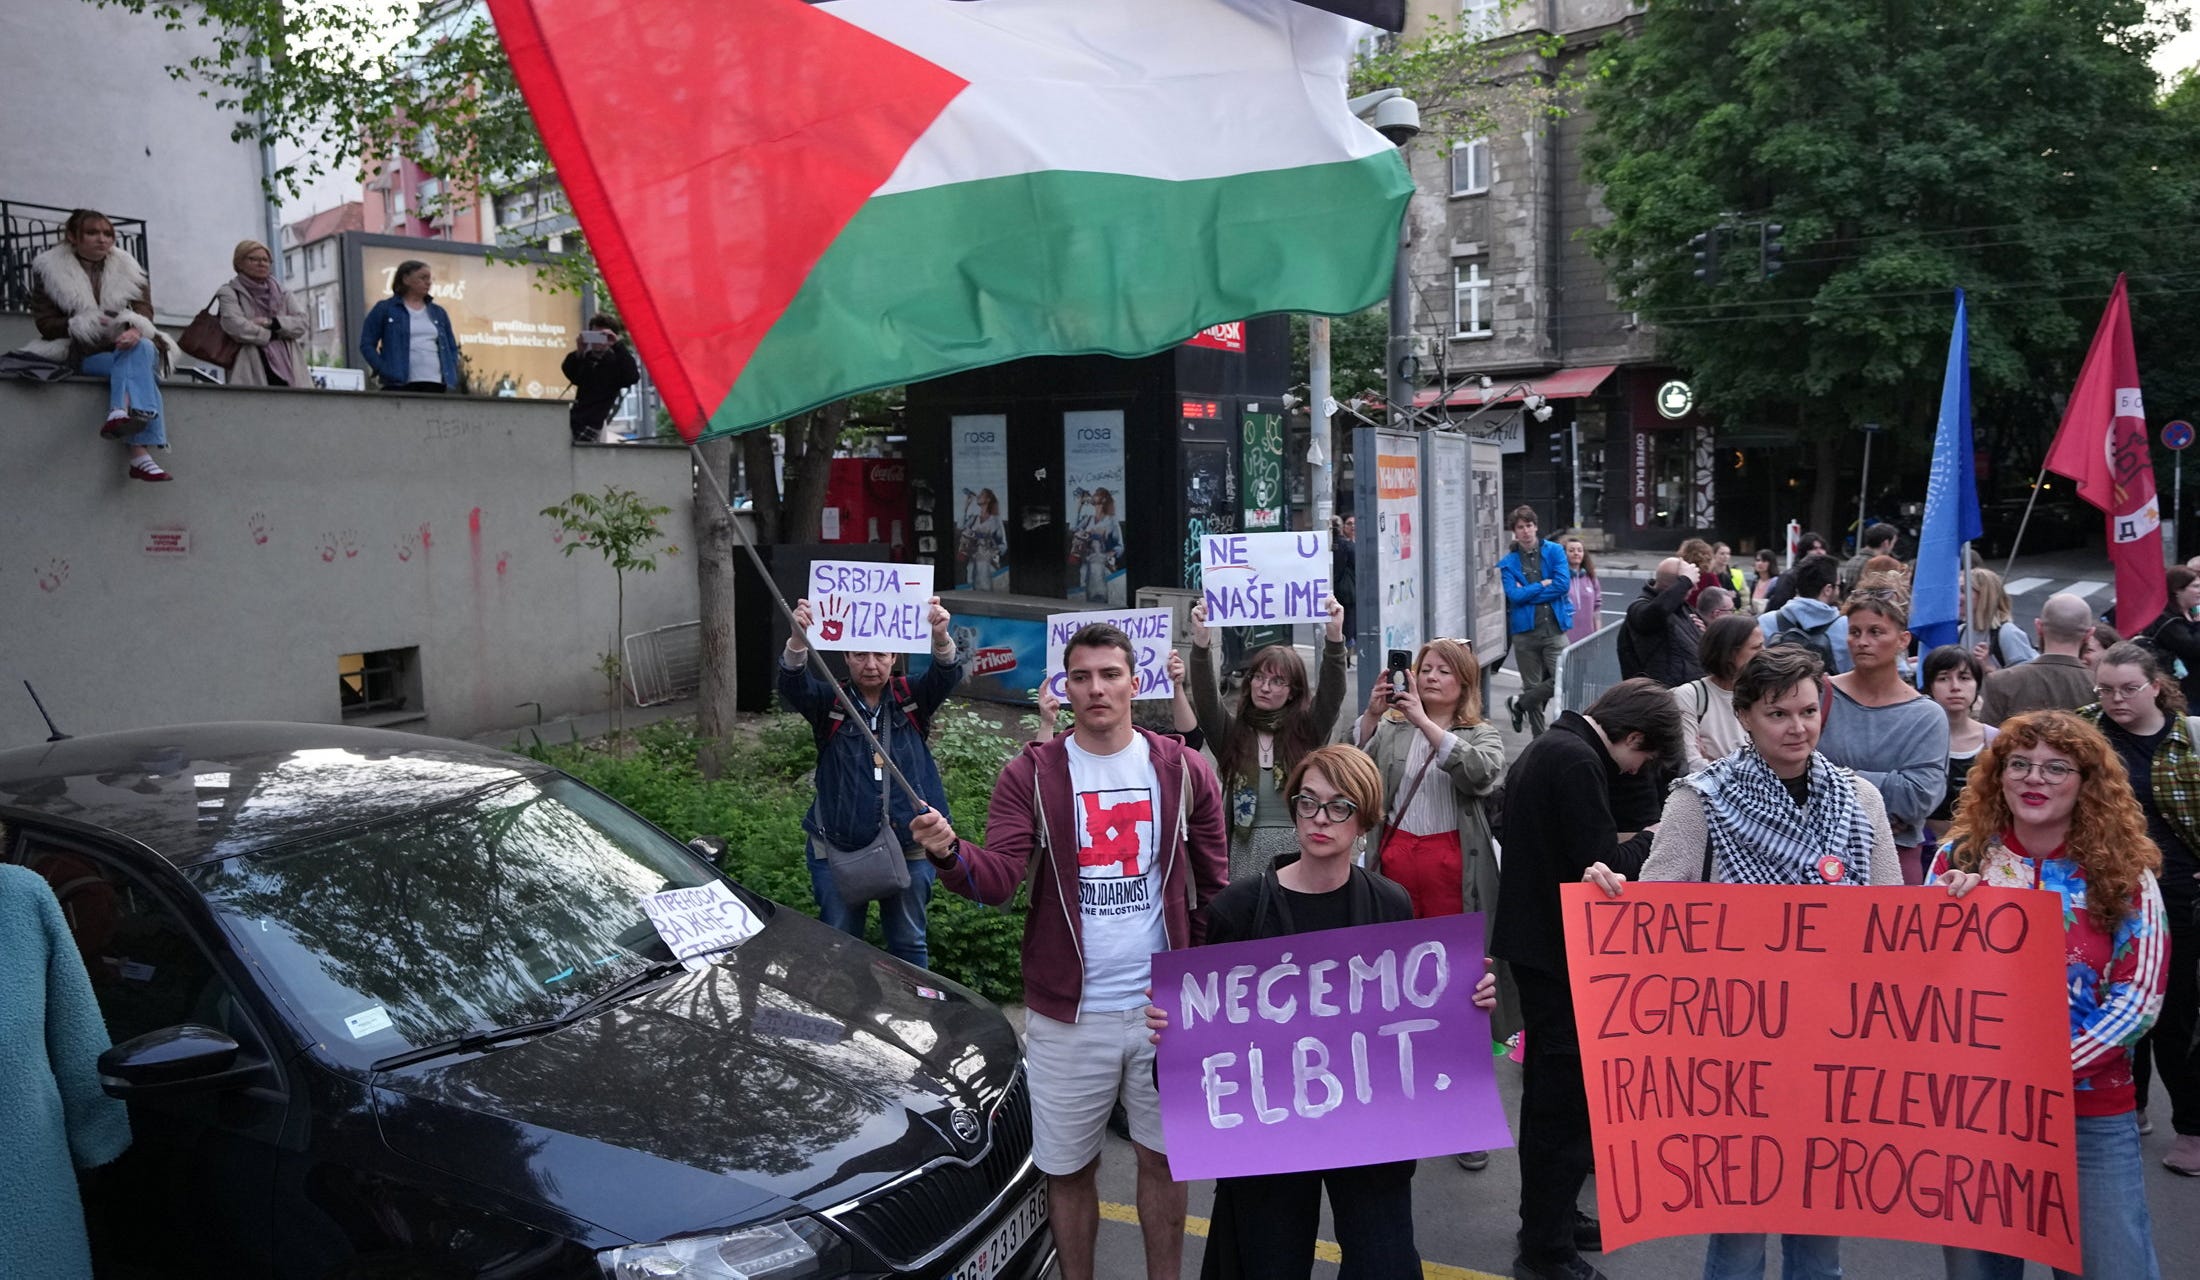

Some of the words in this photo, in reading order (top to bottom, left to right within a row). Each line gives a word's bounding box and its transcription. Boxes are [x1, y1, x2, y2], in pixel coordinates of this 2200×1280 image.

[964, 430, 995, 443] rosa
[1077, 426, 1111, 441] rosa
[1636, 433, 1645, 467] COFFEE
[1636, 468, 1645, 497] PLACE
[1210, 537, 1248, 565] NE
[1297, 533, 1319, 558] U
[1205, 574, 1275, 621] NAŠE
[1285, 579, 1328, 617] IME
[851, 601, 927, 640] IZRAEL
[1079, 878, 1148, 905] SOLIDARNOST
[1085, 907, 1096, 915] NE
[1099, 902, 1151, 916] MILOSTINJA
[1584, 901, 1744, 956] IZRAEL
[1765, 903, 1828, 953] JE
[1863, 902, 2029, 954] NAPAO
[1589, 973, 1789, 1040] ZGRADU
[1830, 982, 2008, 1050] JAVNE
[1201, 1019, 1451, 1129] ELBIT.
[1601, 1056, 1772, 1125] IRANSKE
[1814, 1064, 2065, 1147] TELEVIZIJE
[1608, 1140, 1642, 1223] U
[1657, 1134, 1783, 1211] SRED
[1802, 1137, 2074, 1244] PROGRAMA
